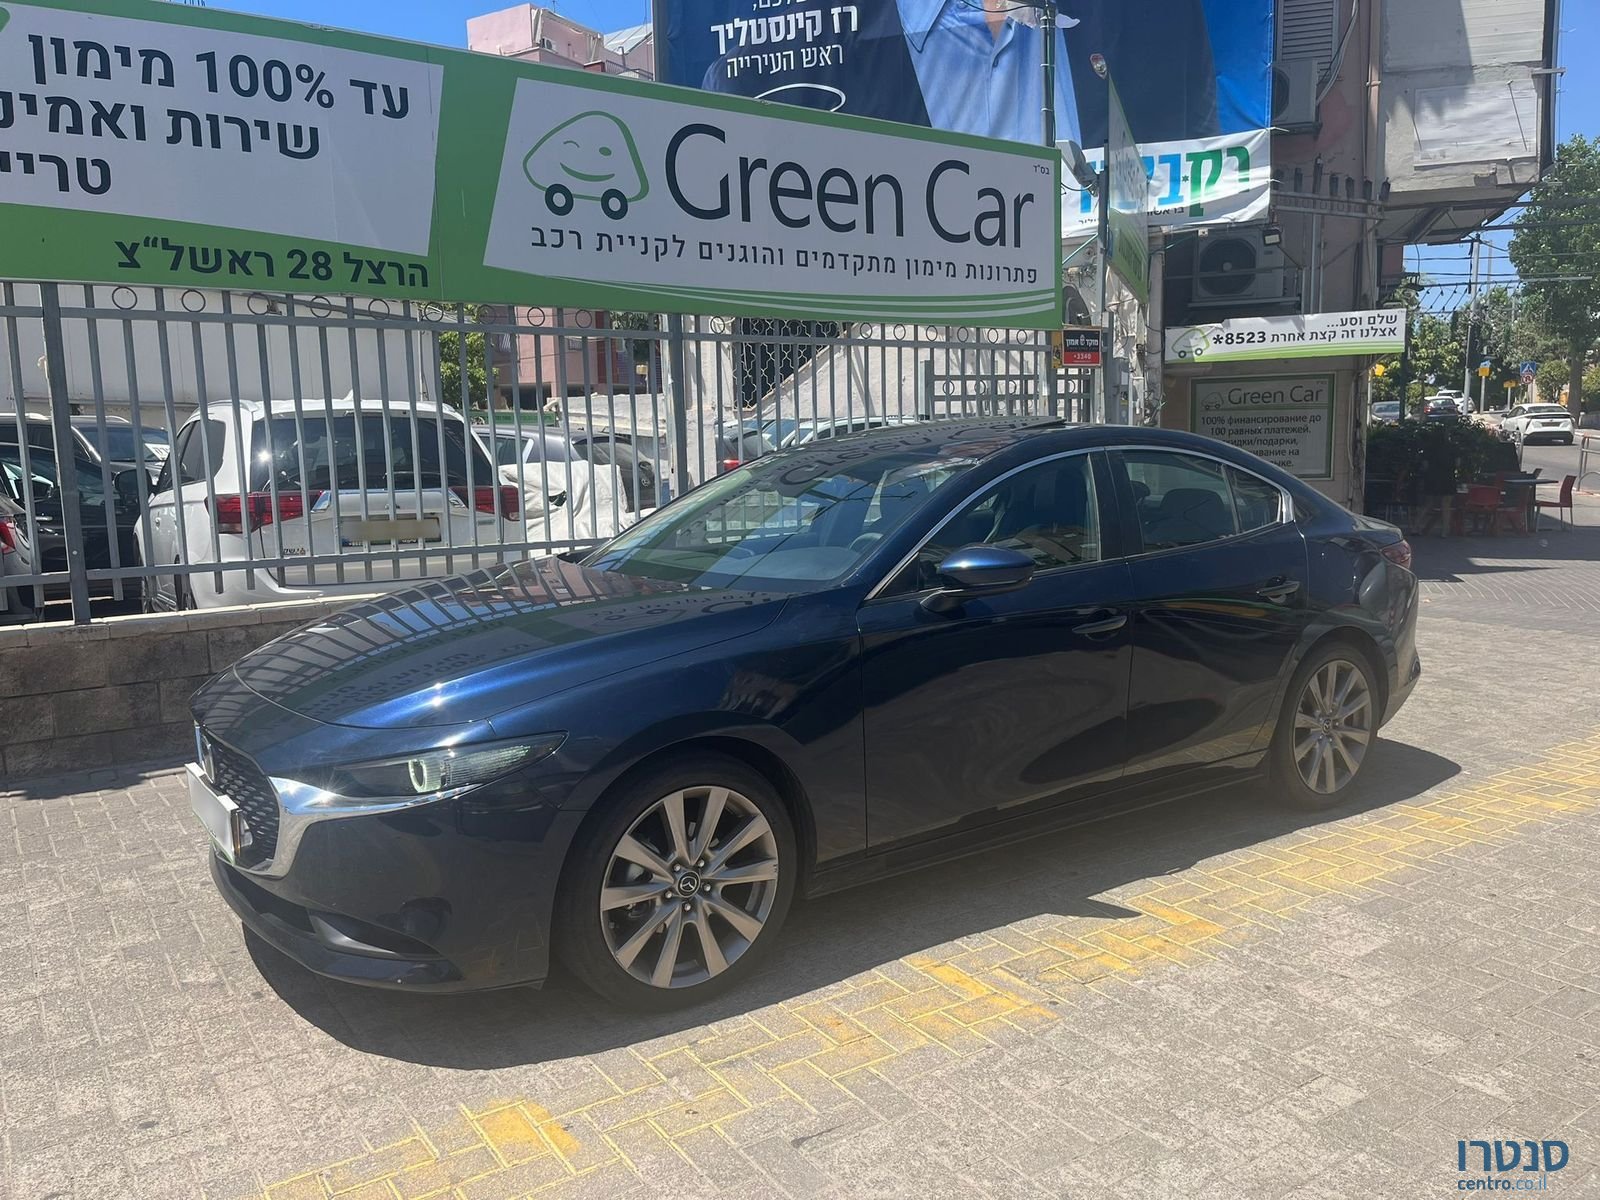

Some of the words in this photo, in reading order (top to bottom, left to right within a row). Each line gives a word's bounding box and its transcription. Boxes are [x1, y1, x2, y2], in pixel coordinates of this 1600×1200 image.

[831, 5, 858, 33] רז
[711, 8, 822, 54] קינסטליך
[28, 34, 174, 87] מימון
[727, 50, 794, 78] העירייה
[801, 45, 843, 68] ראש
[196, 52, 334, 108] 100%
[350, 79, 408, 119] עד
[166, 109, 320, 159] שירות
[665, 123, 904, 237] Green
[926, 160, 1034, 248] Car
[532, 227, 581, 249] רכב
[596, 232, 685, 262] לקניית
[287, 249, 332, 280] 28
[699, 241, 783, 265] והוגנים
[797, 250, 895, 276] מתקדמים
[344, 252, 428, 287] הרצל
[906, 258, 956, 279] מימון
[966, 263, 1036, 284] פתרונות
[1367, 313, 1397, 325] שלם
[1270, 332, 1305, 343] אחרת
[1309, 331, 1337, 342] קצת
[1341, 329, 1355, 338] זה
[1360, 327, 1397, 338] אצלנו
[1228, 388, 1284, 405] Green
[1290, 385, 1323, 402] Car
[1201, 416, 1226, 425] 100%
[1227, 414, 1308, 426] финансирование
[1309, 414, 1321, 424] до
[1210, 427, 1226, 436] 100
[1228, 427, 1262, 438] равных
[1289, 448, 1300, 456] на
